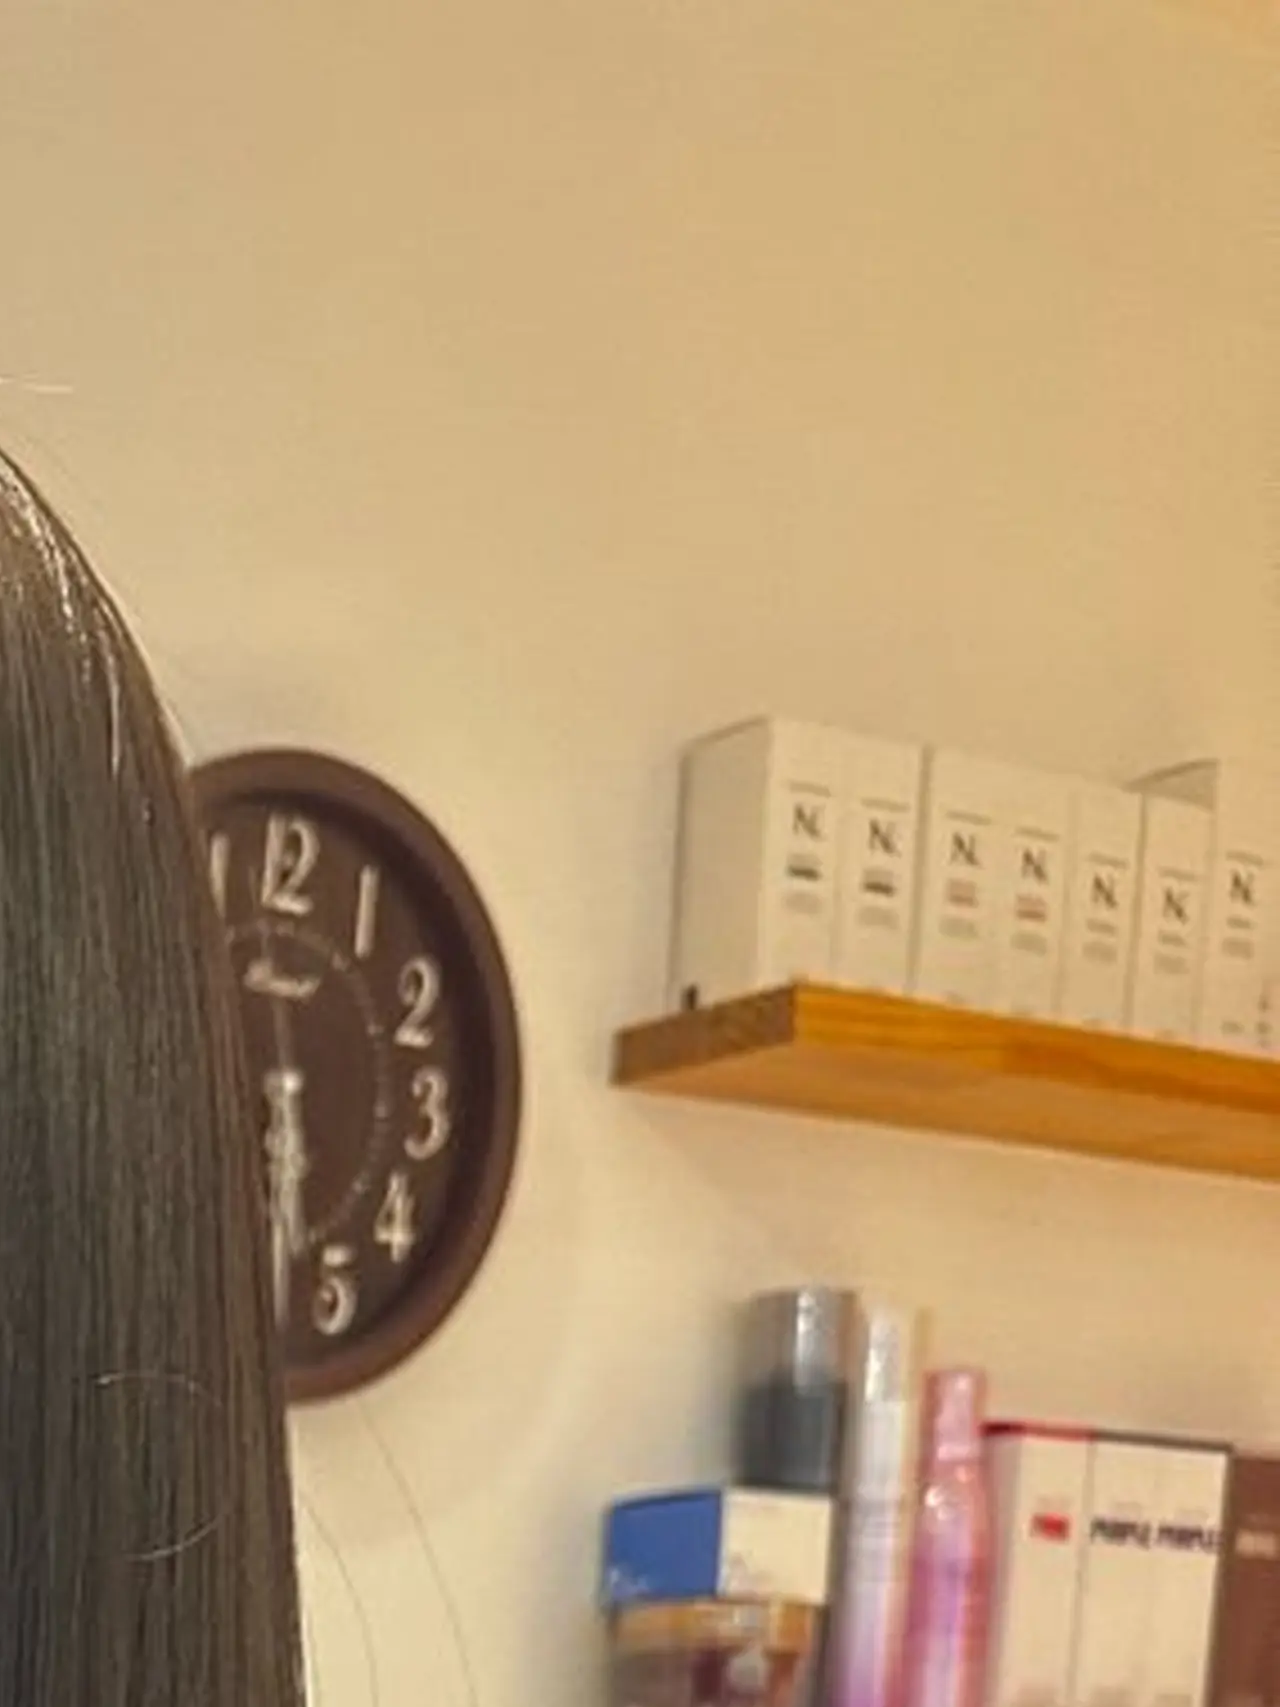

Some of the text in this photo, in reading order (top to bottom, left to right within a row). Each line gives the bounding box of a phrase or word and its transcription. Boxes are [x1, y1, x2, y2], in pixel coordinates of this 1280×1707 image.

[261, 815, 320, 917] 12
[354, 866, 380, 960] 1
[395, 957, 440, 1048] 2
[404, 1068, 450, 1161] 3
[374, 1172, 415, 1263] 4
[312, 1246, 358, 1336] 5
